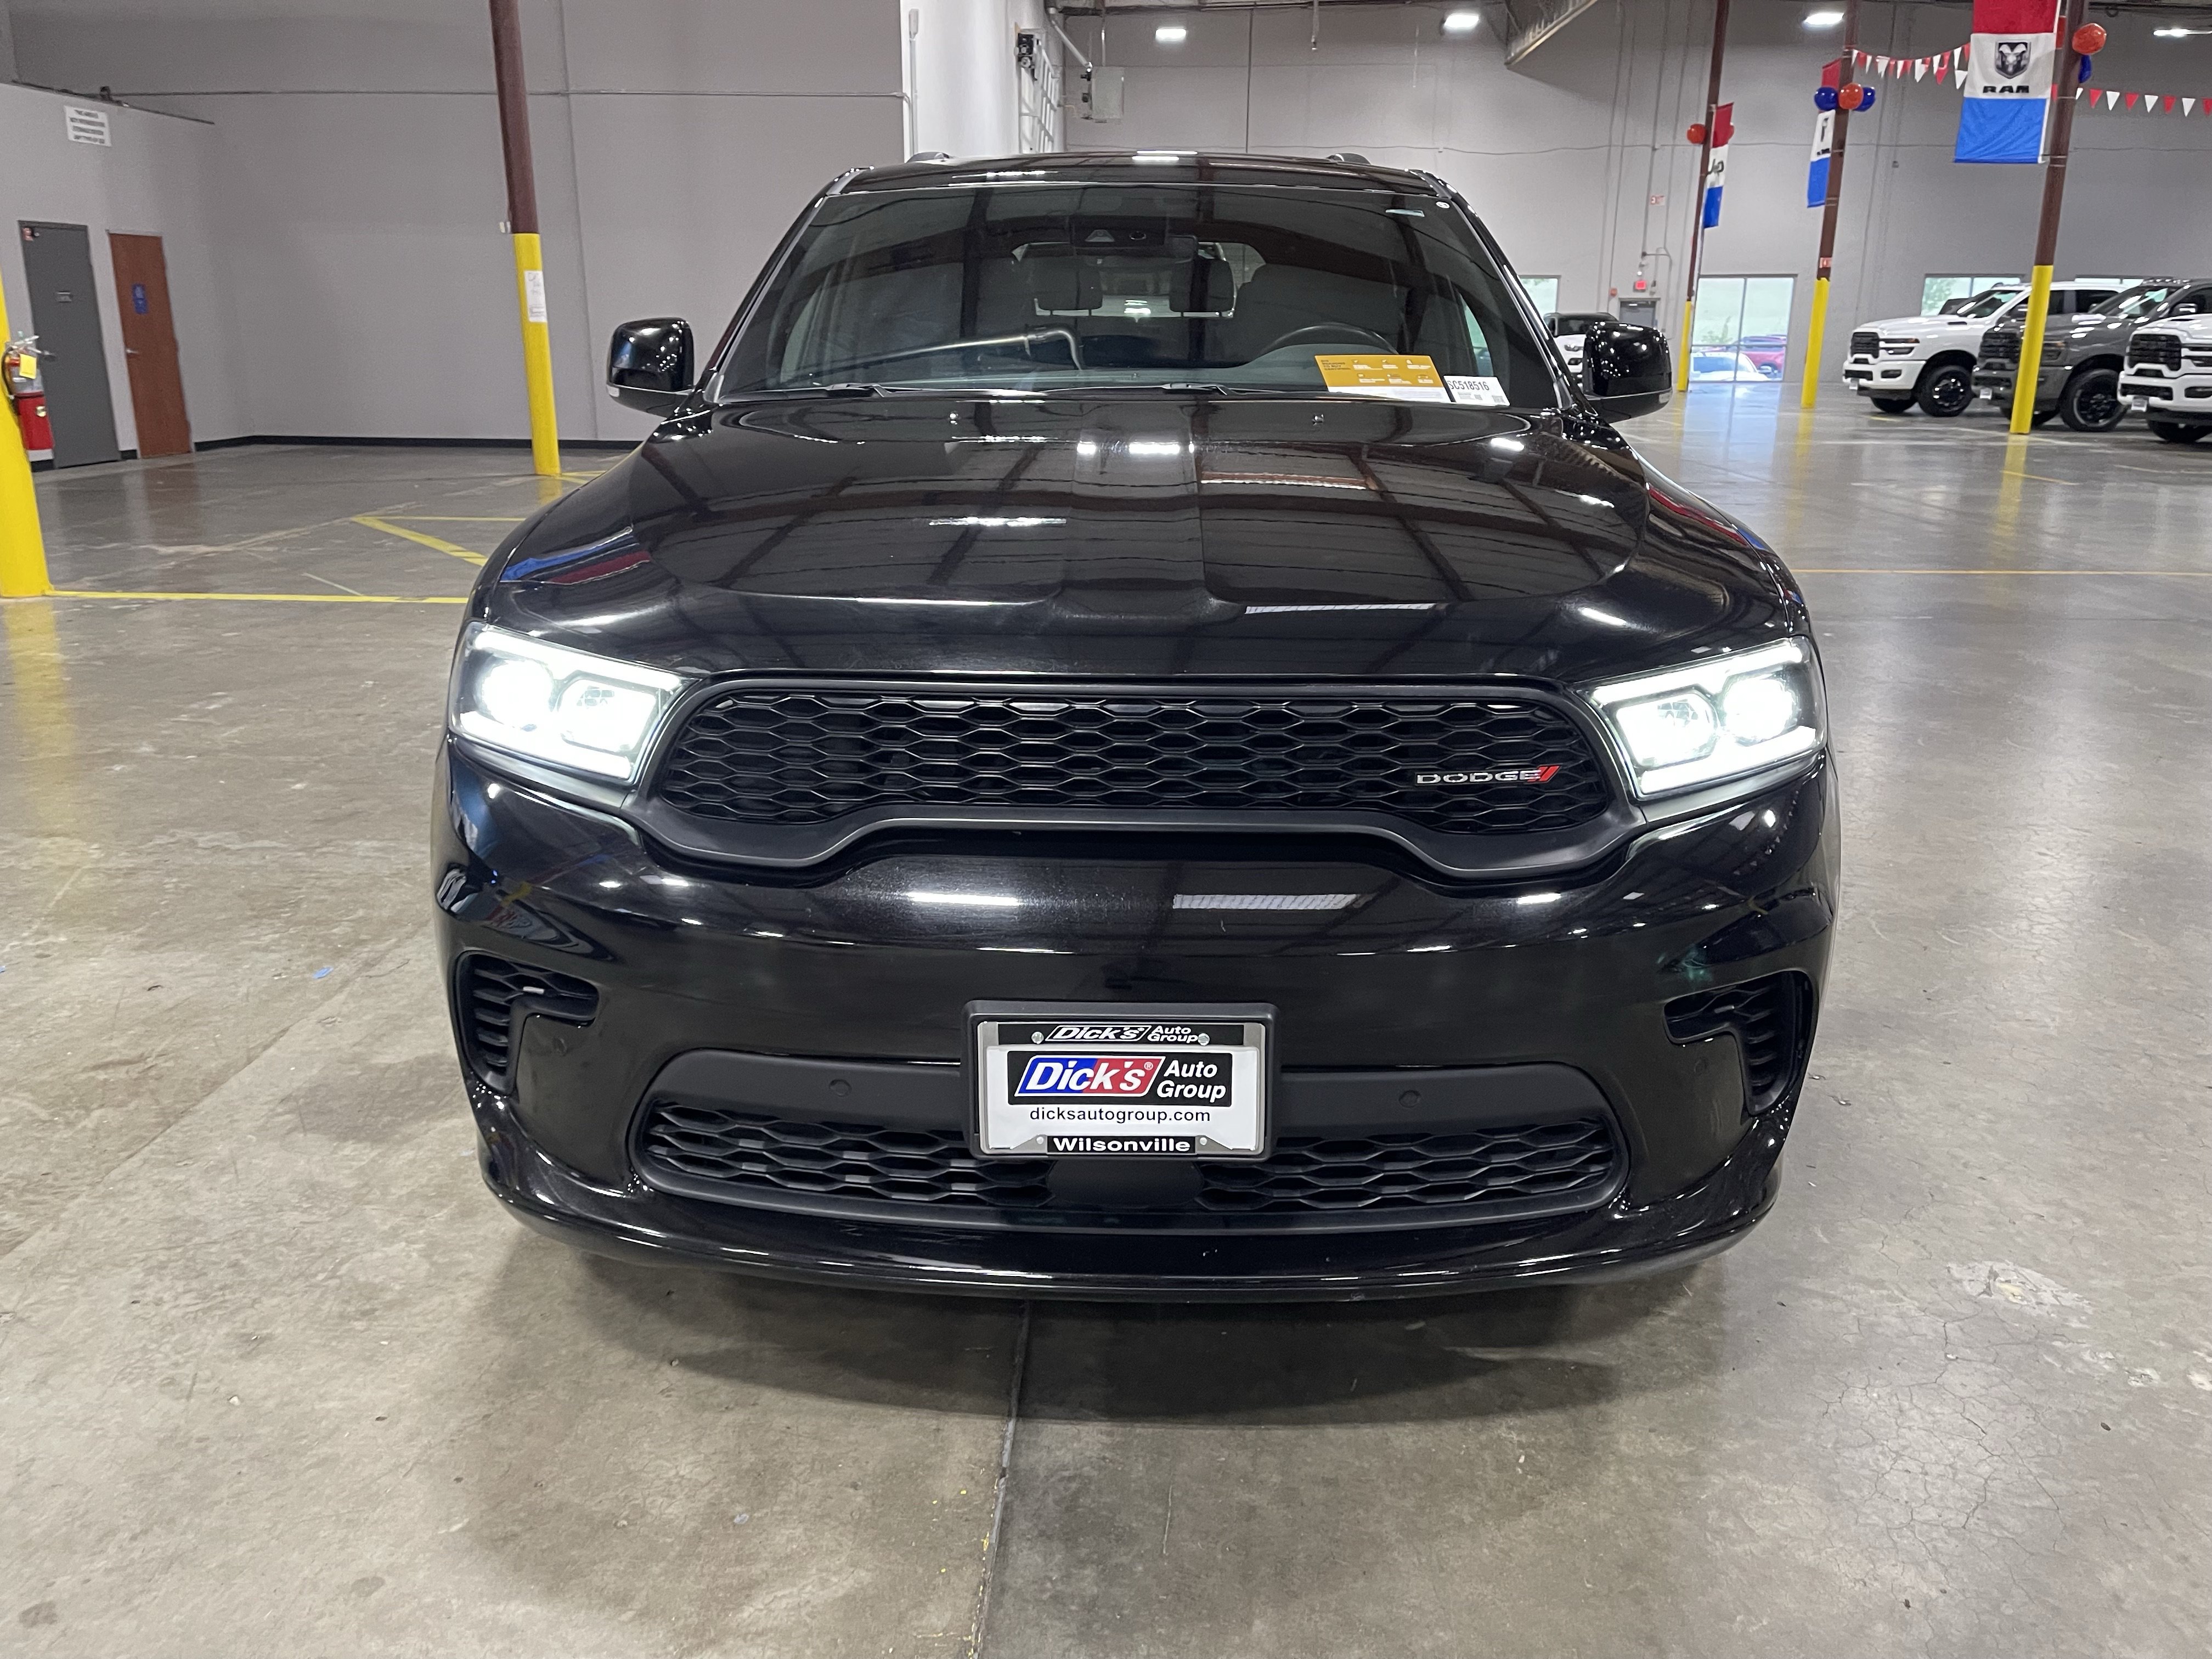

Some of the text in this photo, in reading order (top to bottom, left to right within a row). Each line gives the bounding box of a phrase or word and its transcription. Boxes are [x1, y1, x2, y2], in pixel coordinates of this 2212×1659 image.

[1982, 85, 2030, 94] RAM
[1707, 158, 1725, 176] Jp
[1417, 770, 1542, 784] DODGE
[1053, 1025, 1192, 1040] Dick's Auto
[1147, 1032, 1199, 1043] Group
[1025, 1059, 1218, 1091] Dick's Auto
[1156, 1079, 1227, 1103] Group
[1030, 1107, 1211, 1124] dicksautogroup.com
[1053, 1137, 1191, 1152] Wilsonville
